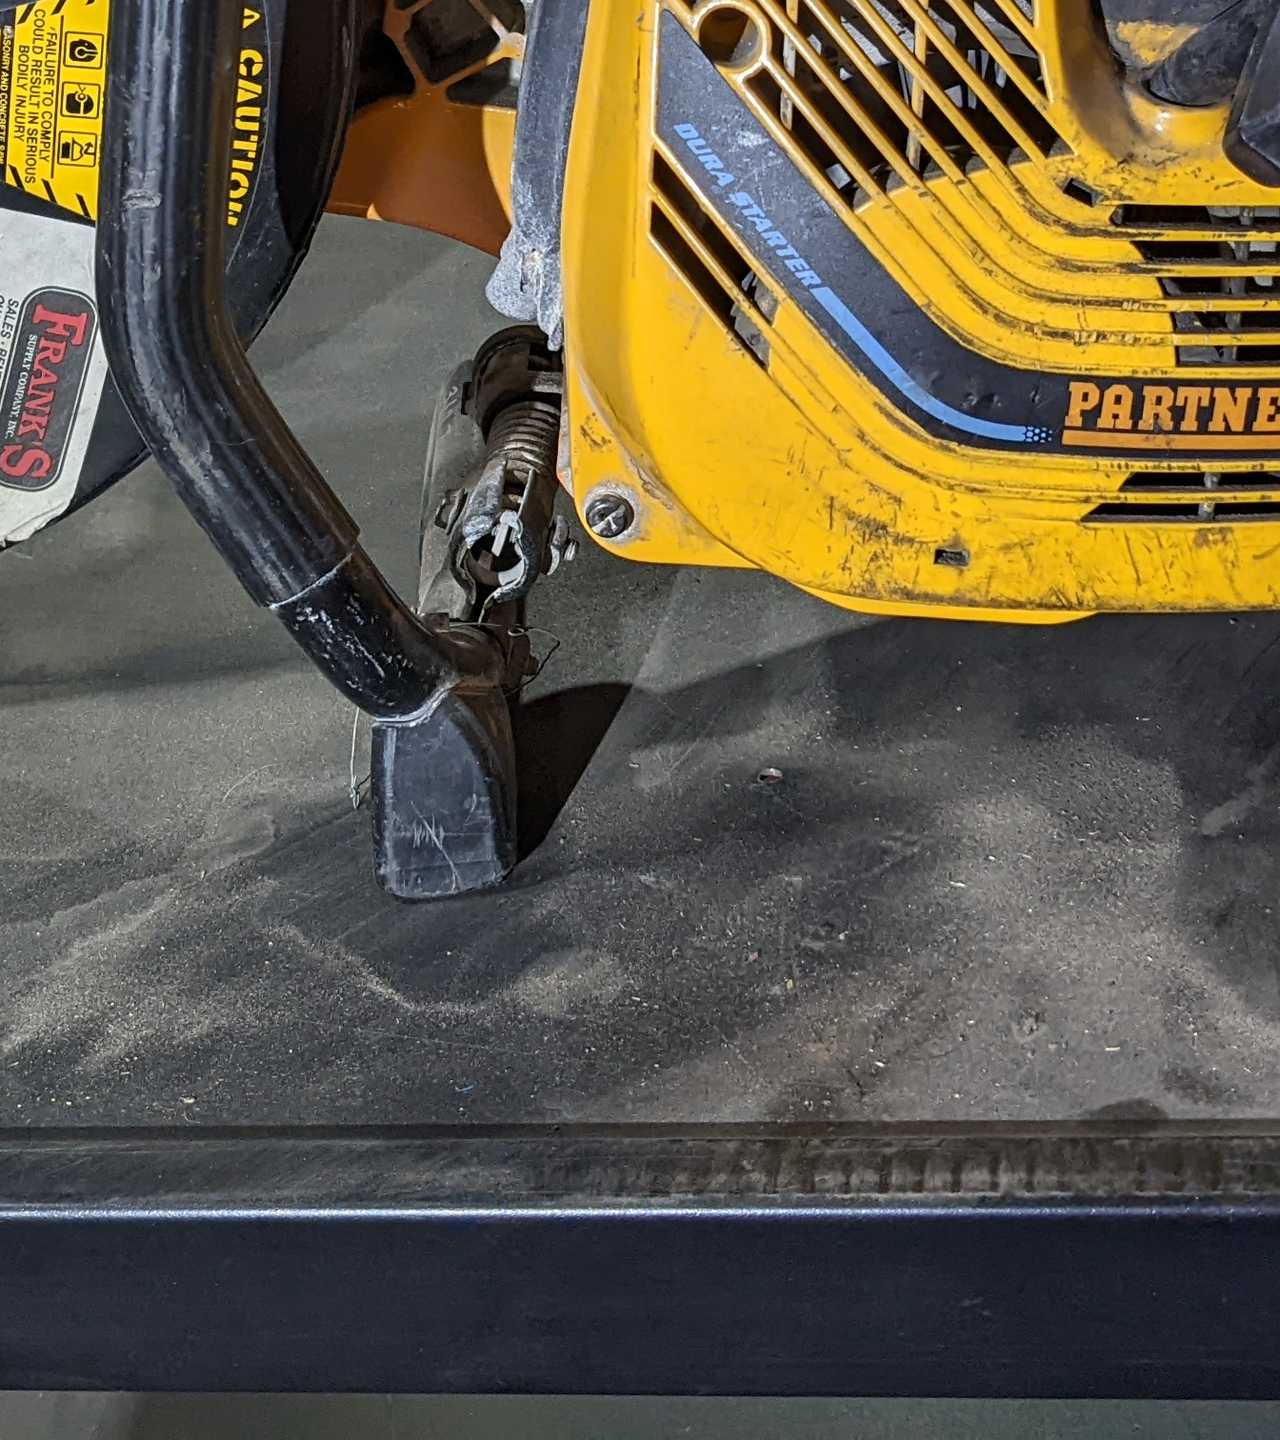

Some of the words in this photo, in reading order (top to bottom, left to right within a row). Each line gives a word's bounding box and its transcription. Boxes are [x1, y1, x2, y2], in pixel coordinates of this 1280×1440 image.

[31, 8, 46, 55] COULD
[0, 73, 10, 93] AND
[17, 44, 30, 92] BODILY
[44, 31, 57, 88] FAILURE
[29, 58, 43, 109] RESULT
[43, 88, 54, 108] TO
[12, 95, 25, 142] INJURY
[27, 111, 39, 125] IN
[39, 109, 53, 162] COMPLY
[24, 127, 39, 185] SERIOUS
[673, 123, 736, 187] DURA
[732, 191, 823, 286] STARTER
[0, 298, 19, 340] SALES
[19, 334, 38, 371] SUPPLY
[4, 418, 16, 440] INC.
